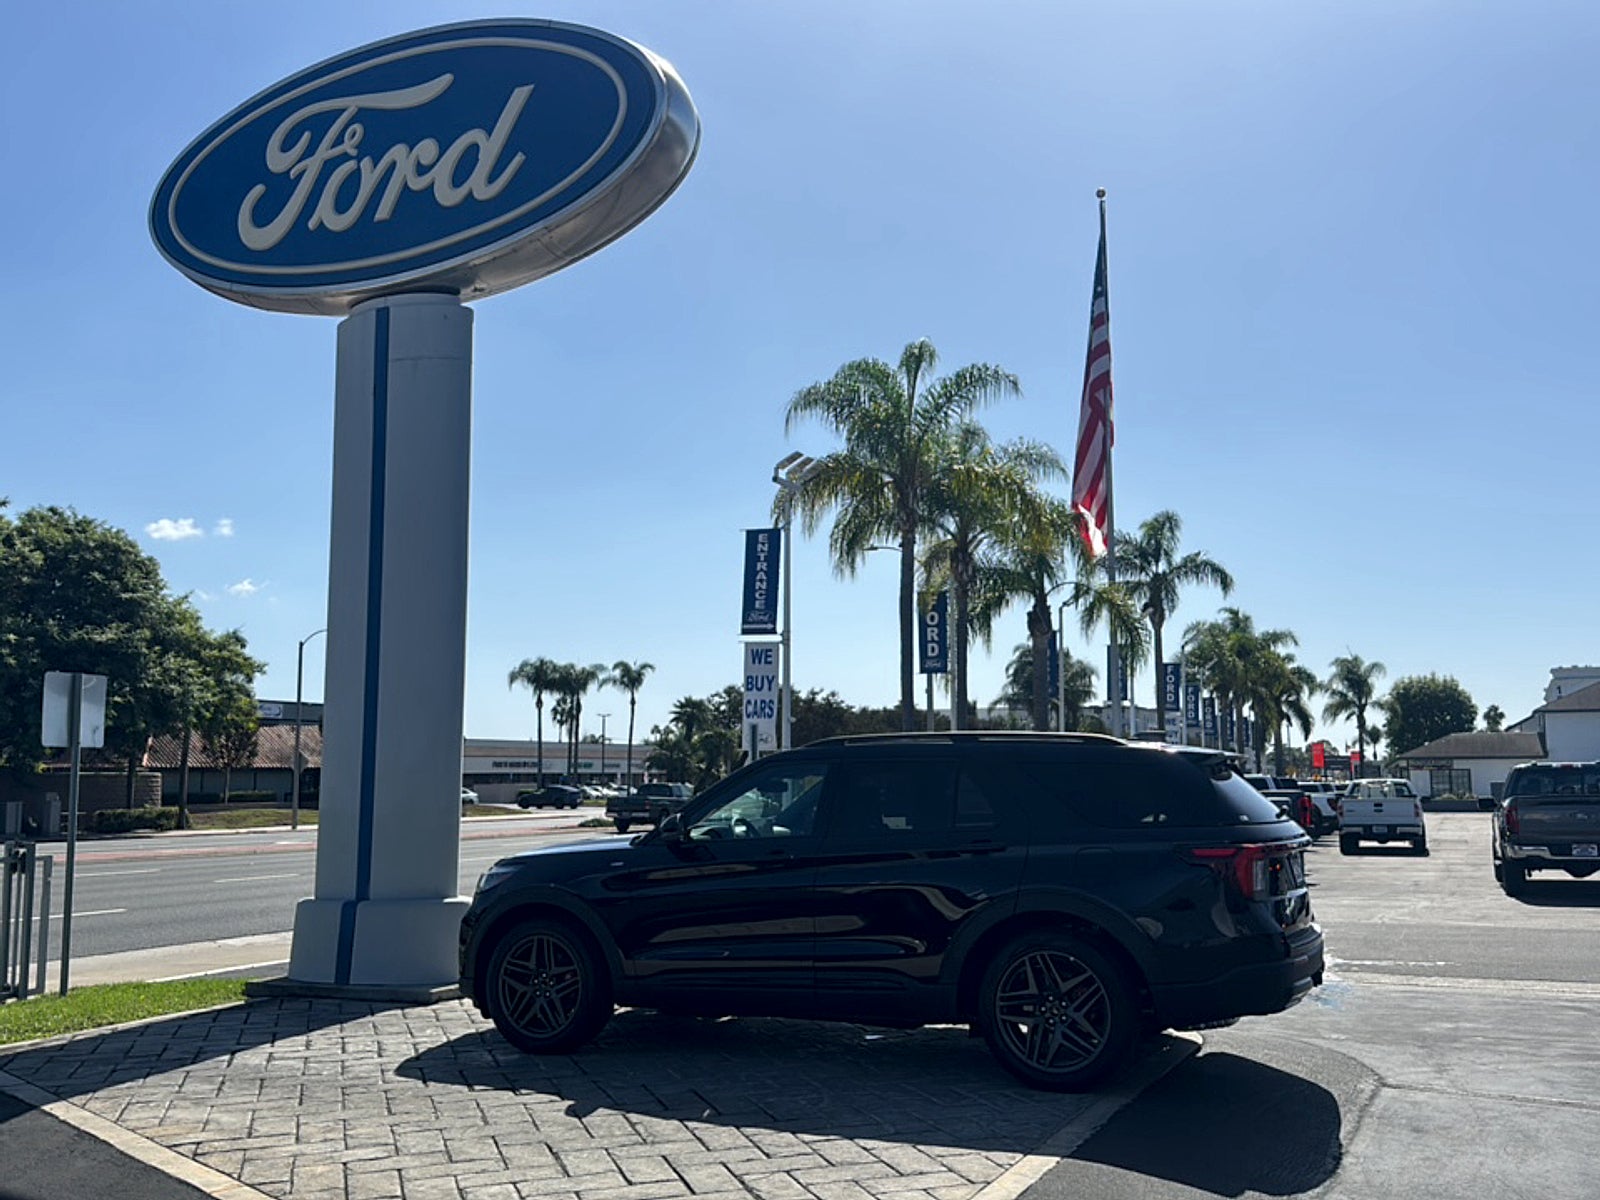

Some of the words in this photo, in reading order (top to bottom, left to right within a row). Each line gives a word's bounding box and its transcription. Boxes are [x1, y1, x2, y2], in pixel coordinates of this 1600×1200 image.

[238, 73, 534, 250] Ford
[755, 533, 769, 609] ENTRANCE
[751, 648, 773, 665] WE
[746, 674, 775, 691] BUY
[1166, 665, 1175, 702] FORD
[745, 699, 774, 719] CARS
[1187, 686, 1195, 718] FORD
